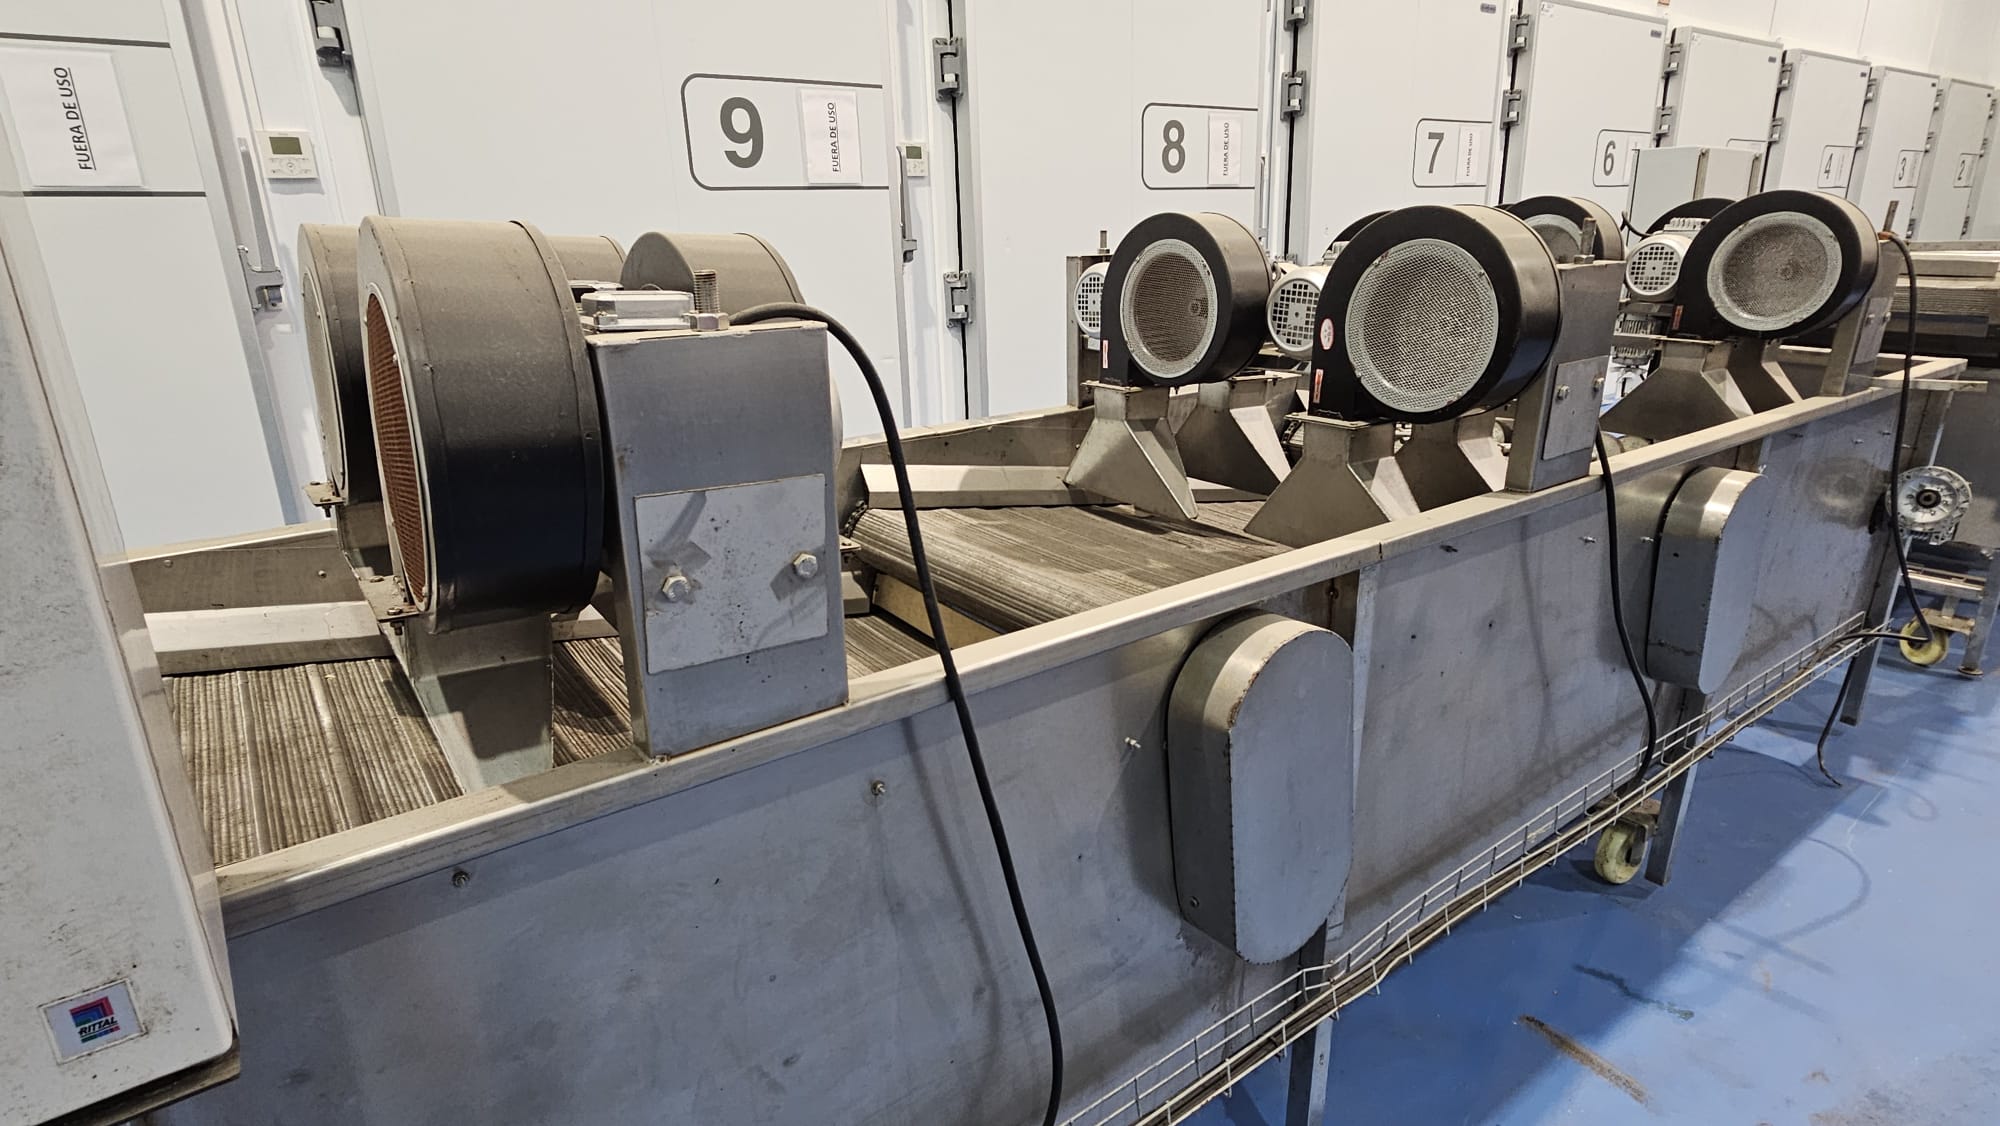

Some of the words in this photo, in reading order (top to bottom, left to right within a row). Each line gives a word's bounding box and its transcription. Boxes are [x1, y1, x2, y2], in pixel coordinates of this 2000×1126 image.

[53, 67, 73, 97] USO
[62, 102, 80, 120] DE
[827, 102, 836, 123] USO
[720, 97, 764, 168] 9
[829, 126, 837, 138] DE
[1162, 119, 1186, 174] 8
[69, 125, 93, 170] FUERA
[830, 141, 839, 172] FUERA
[1428, 131, 1445, 174] 7
[1603, 140, 1616, 176] 6
[1823, 152, 1834, 180] 4
[1898, 157, 1907, 181] 3
[1957, 160, 1966, 181] 2
[78, 1016, 118, 1036] RITTAL
